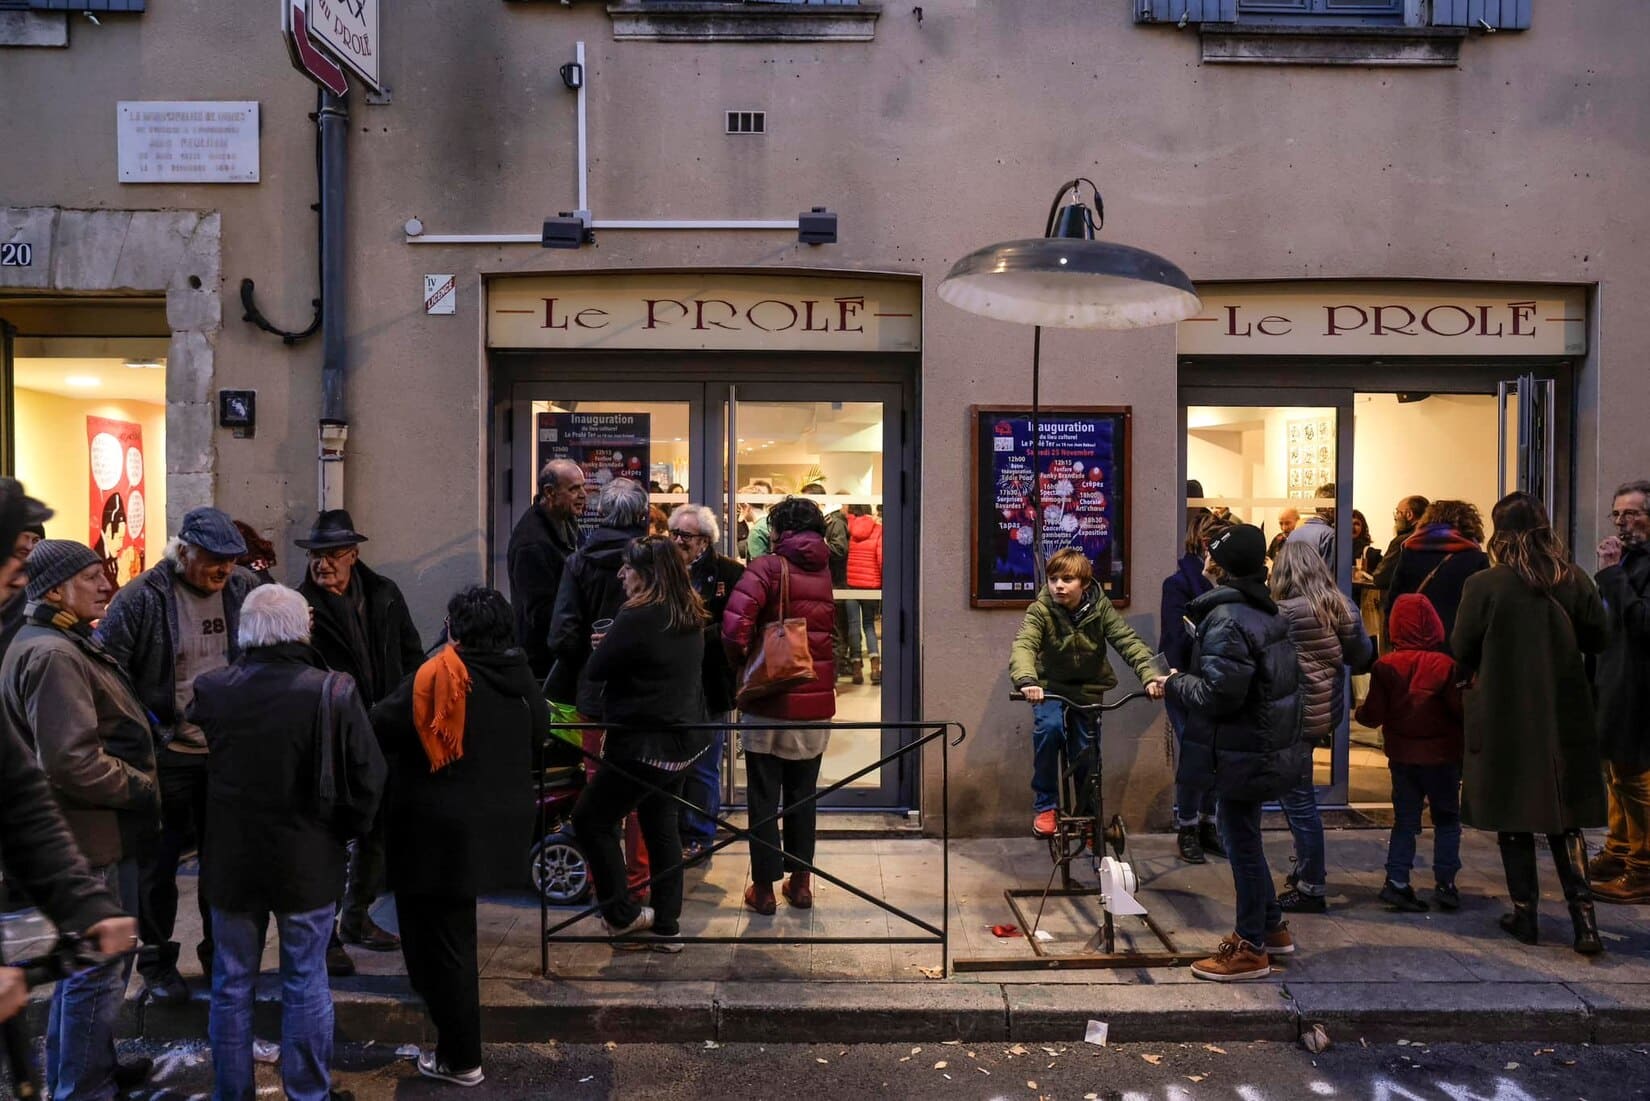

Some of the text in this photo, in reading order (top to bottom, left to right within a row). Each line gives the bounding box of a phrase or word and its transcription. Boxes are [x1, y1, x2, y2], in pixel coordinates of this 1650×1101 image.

[2, 243, 31, 265] 20
[540, 296, 865, 333] Le PROLÉ
[1223, 301, 1537, 338] Le PROLÉ
[571, 414, 634, 425] Inauguration
[1061, 448, 1095, 456] Novembre
[1081, 481, 1104, 489] Crêpes
[998, 522, 1020, 530] Tapas
[202, 617, 225, 635] 28
